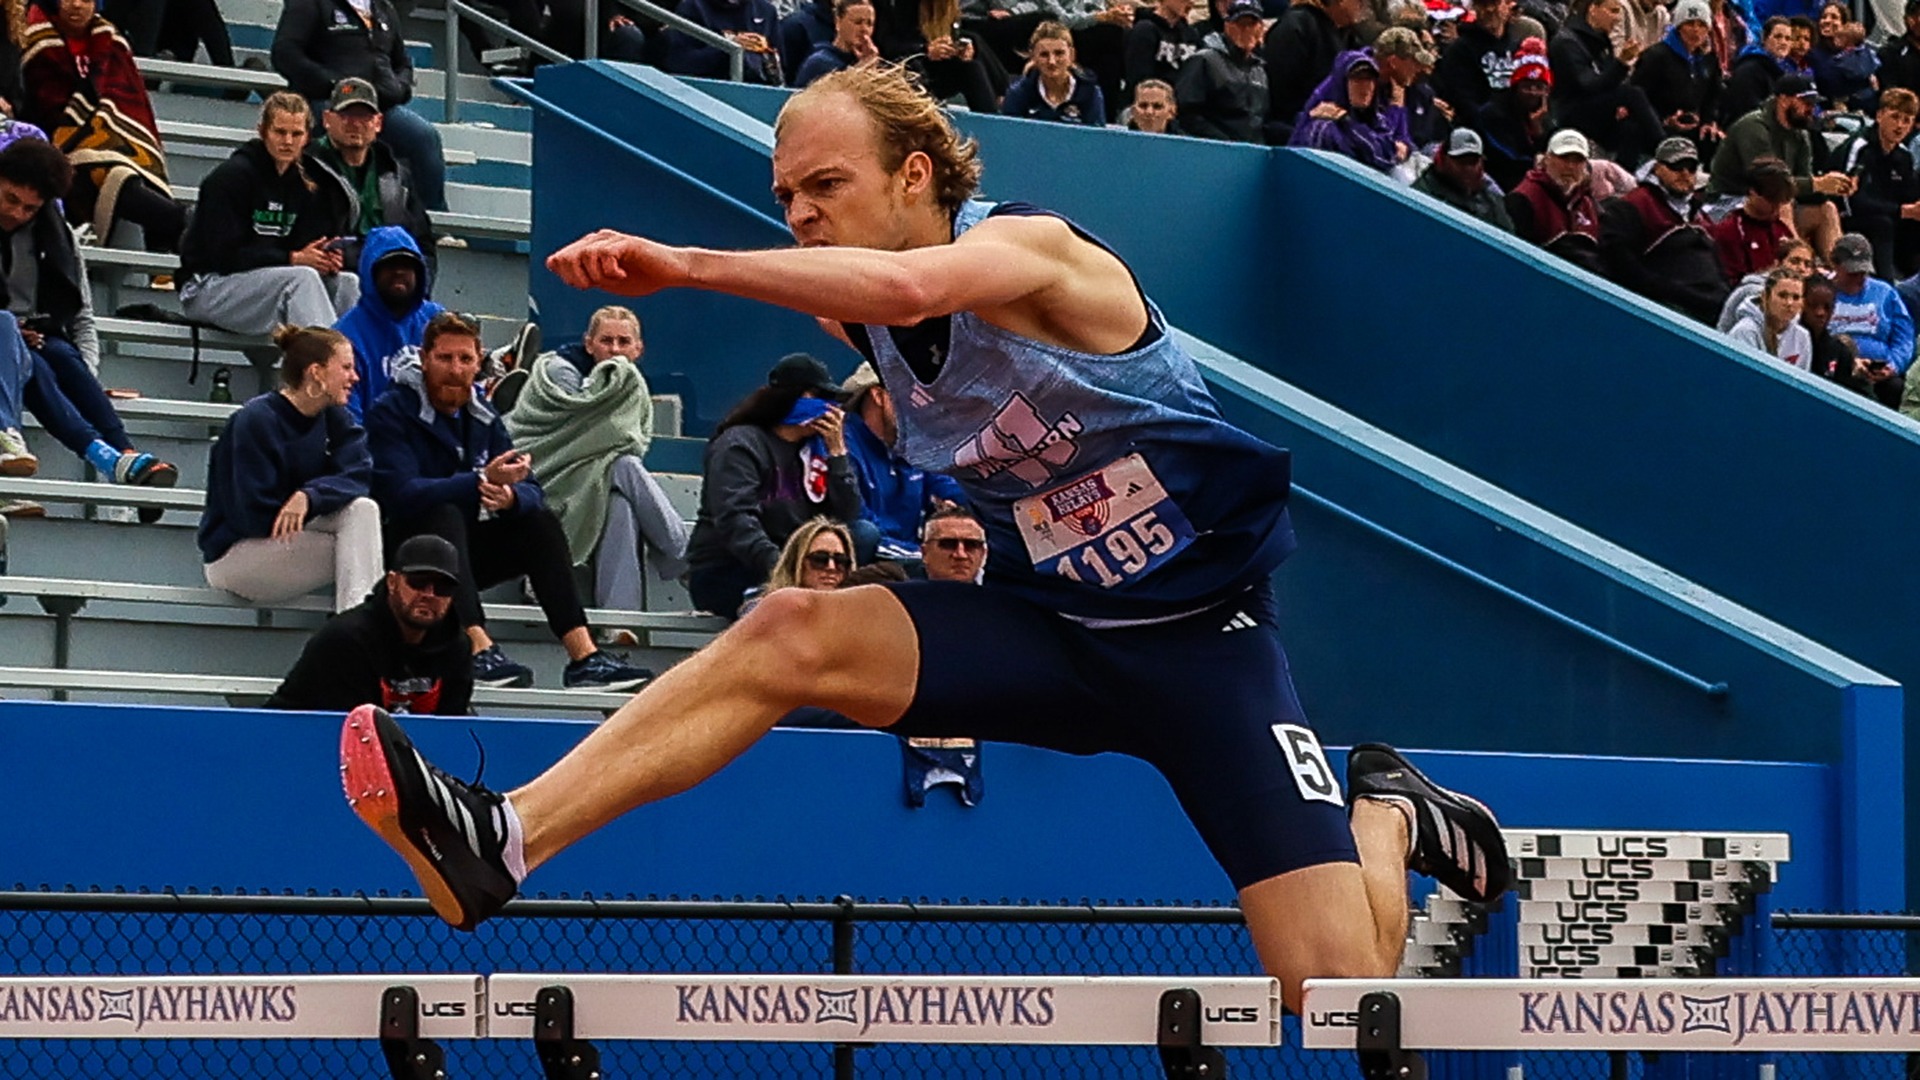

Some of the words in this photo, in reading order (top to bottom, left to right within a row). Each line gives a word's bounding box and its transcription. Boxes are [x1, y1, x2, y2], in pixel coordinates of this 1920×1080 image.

[1050, 478, 1098, 503] KANSAS
[1053, 489, 1102, 516] RELAYS
[1057, 511, 1174, 588] 1195
[1284, 730, 1333, 796] 5
[1597, 837, 1668, 858] UCS
[1581, 858, 1653, 879] UCS
[1568, 880, 1639, 901] UCS
[1556, 901, 1628, 923] UCS
[1542, 923, 1614, 945] UCS
[1528, 945, 1600, 966] UCS
[0, 985, 95, 1022] ANSAS
[135, 985, 297, 1033] JAYHAWKS
[421, 1003, 466, 1017] UCS
[494, 1002, 537, 1017] UCS
[676, 985, 811, 1024] KANSAS
[859, 985, 1055, 1036] JAYHAWKS
[1205, 1008, 1258, 1023] UCS
[1310, 1012, 1360, 1027] UCS
[1519, 991, 1675, 1034] KANSAS
